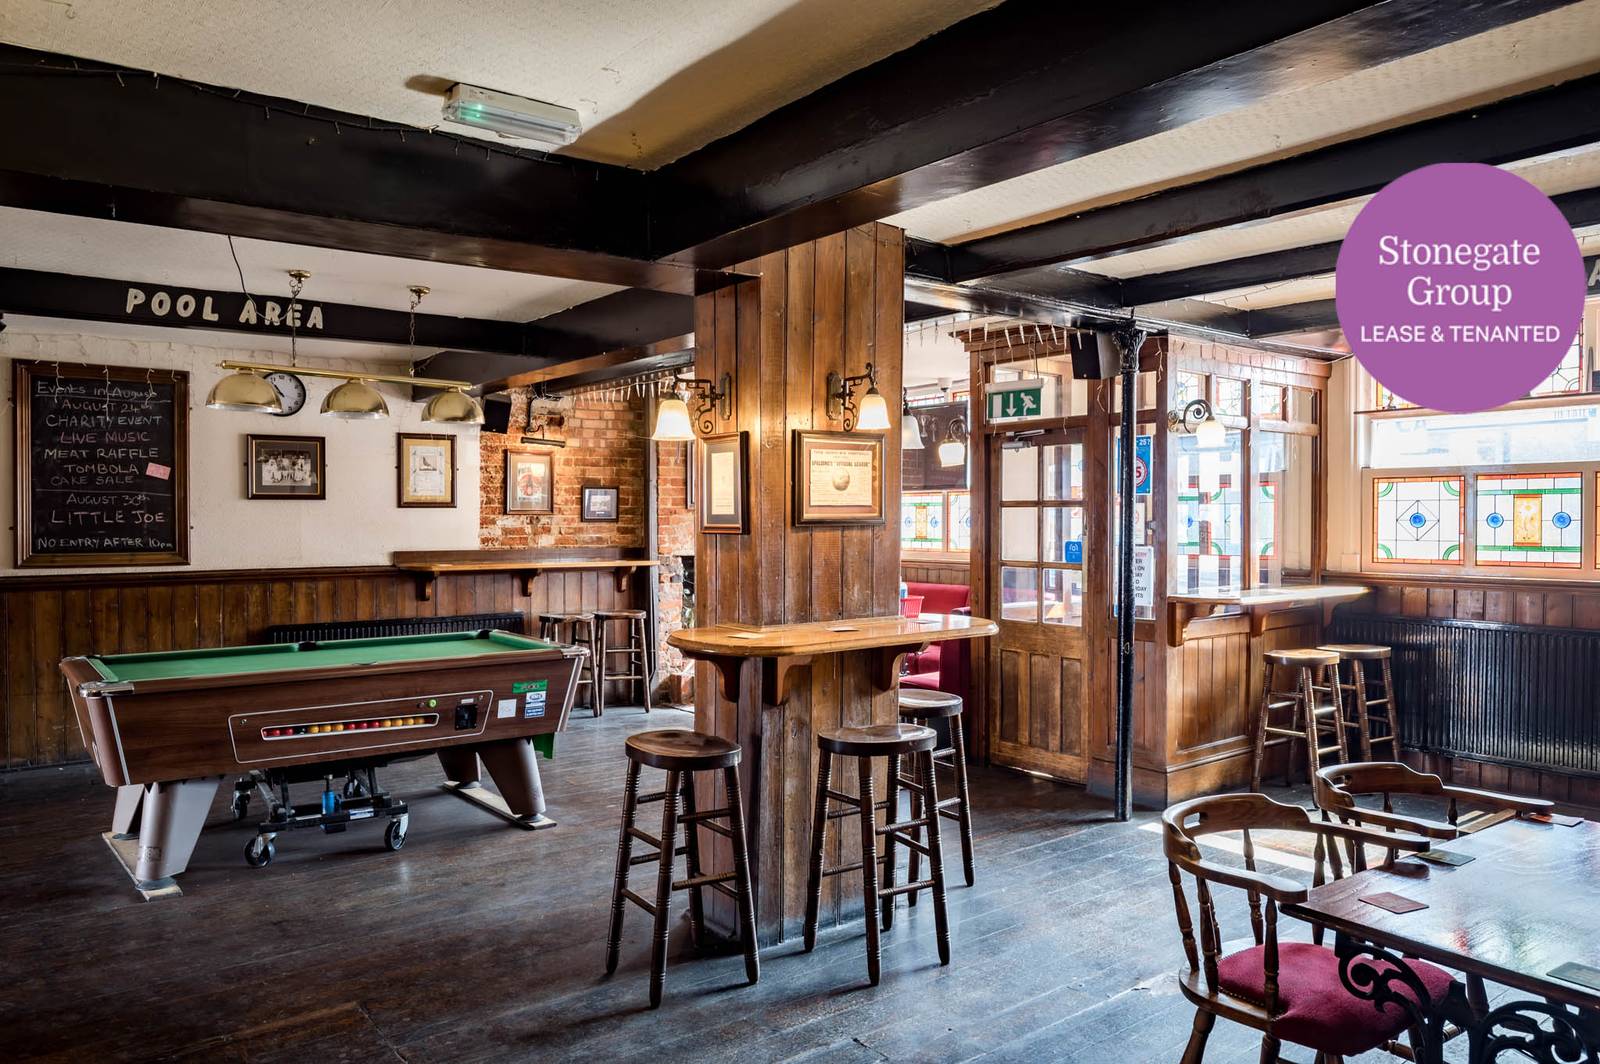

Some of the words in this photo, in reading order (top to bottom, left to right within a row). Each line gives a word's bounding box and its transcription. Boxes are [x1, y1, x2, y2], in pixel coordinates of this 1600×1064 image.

[125, 287, 220, 322] POOL
[238, 299, 324, 330] AREA
[37, 381, 86, 394] Events
[94, 387, 106, 396] in
[61, 399, 118, 412] AUGUST
[45, 414, 114, 430] CHARITY
[117, 415, 162, 425] EVENT
[60, 431, 97, 444] LIVE
[105, 431, 152, 443] MUSIC
[44, 448, 90, 460] MEAT
[96, 447, 160, 459] RAFFLE
[63, 463, 140, 475] TOMBOLA
[50, 475, 89, 487] CAKE
[95, 475, 135, 486] SALE
[66, 493, 118, 506] AUGUST
[51, 509, 126, 526] LITTLE
[131, 509, 166, 525] JOE
[37, 537, 57, 550] NO
[60, 537, 99, 549] ENTRY
[103, 537, 144, 549] AFTER
